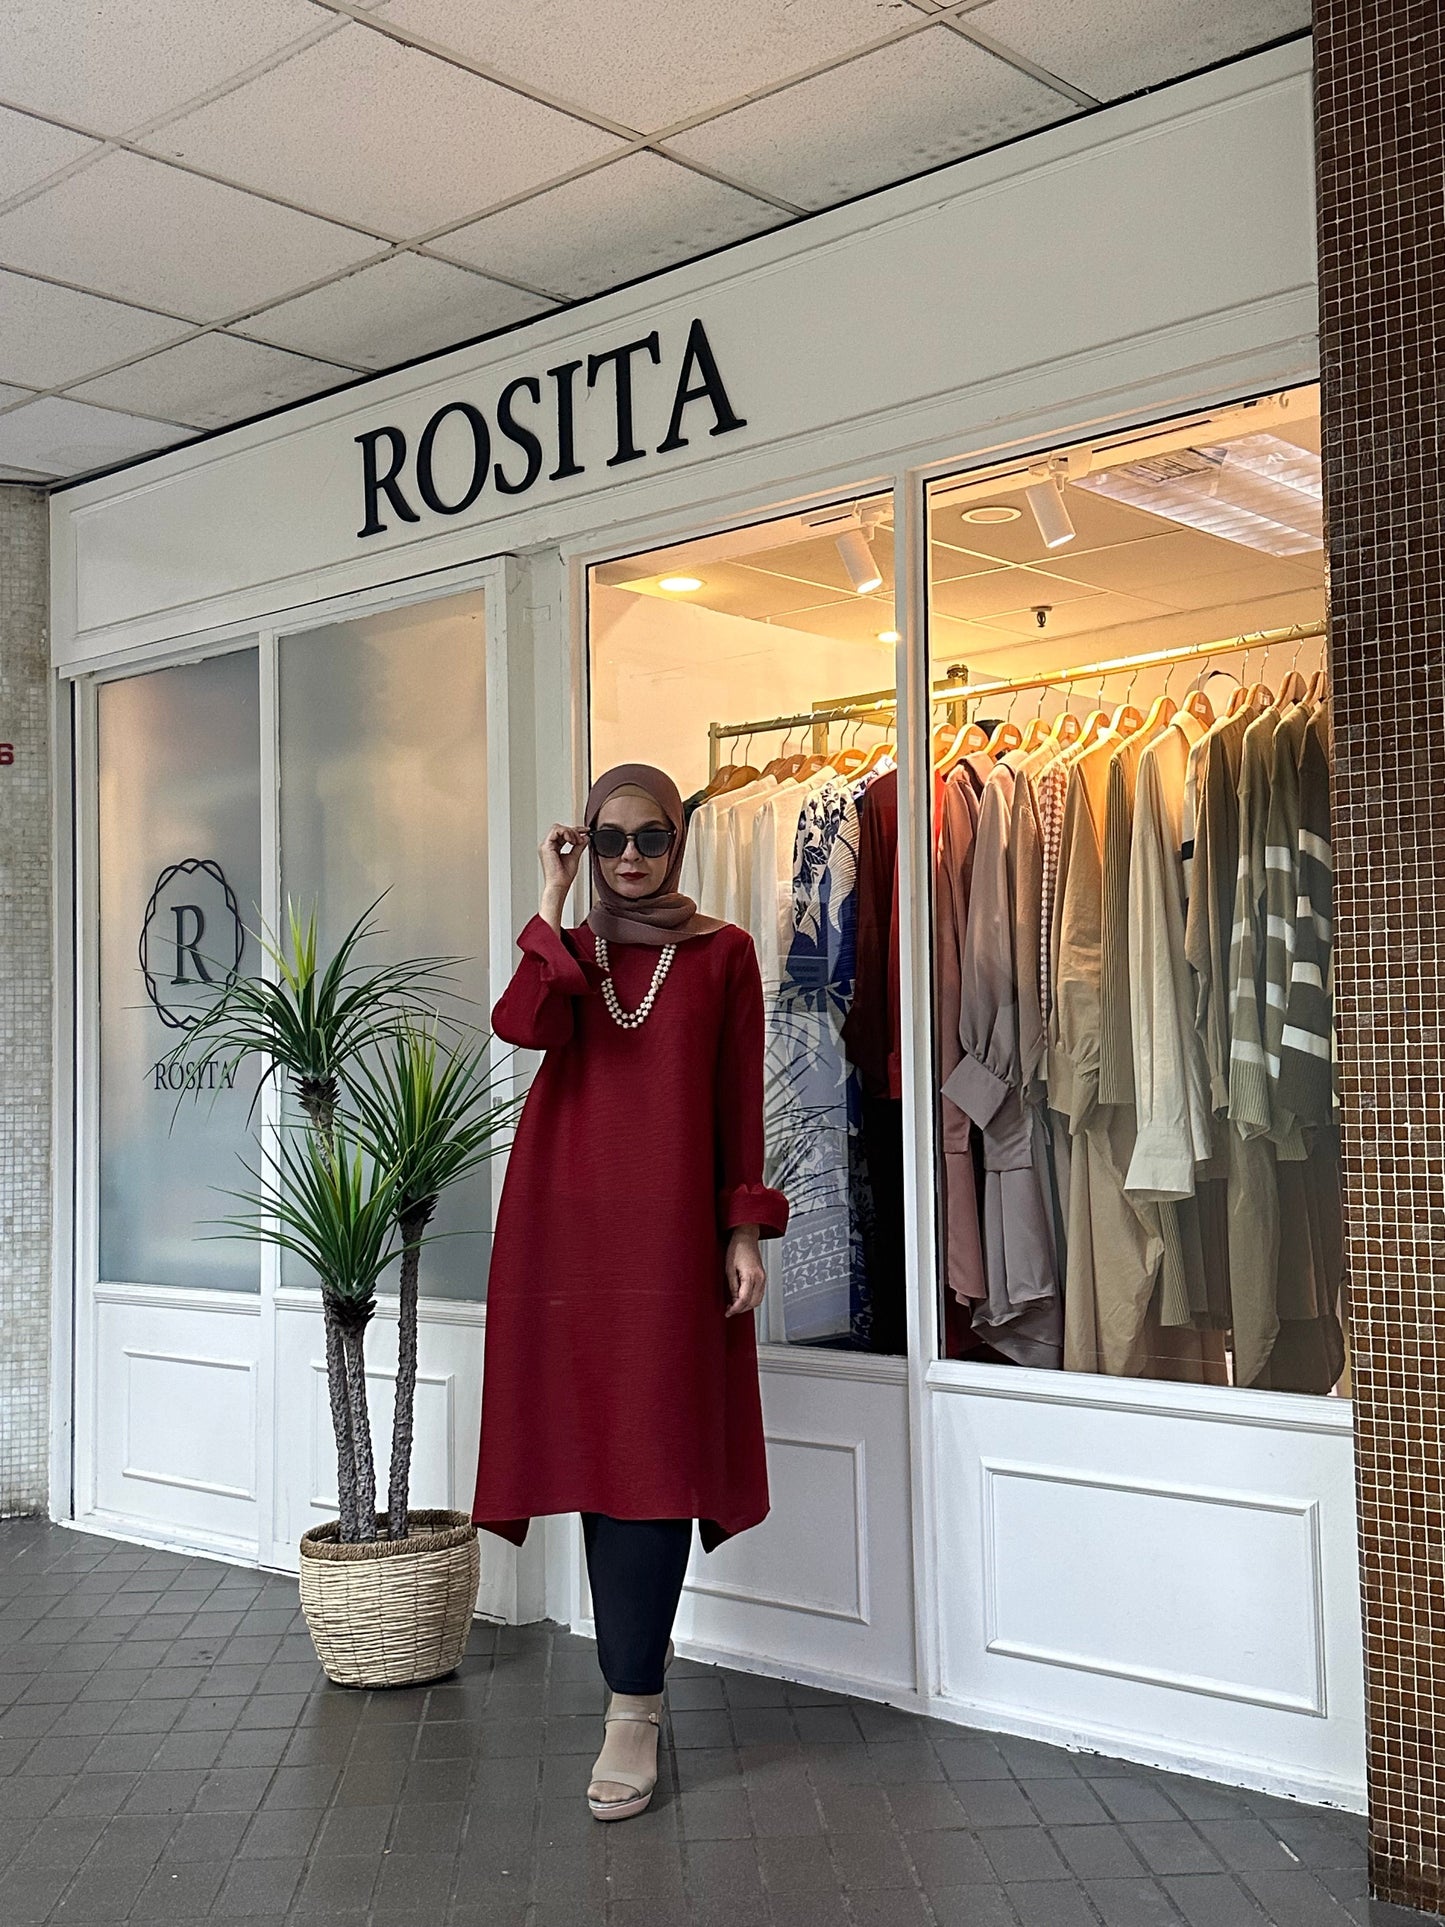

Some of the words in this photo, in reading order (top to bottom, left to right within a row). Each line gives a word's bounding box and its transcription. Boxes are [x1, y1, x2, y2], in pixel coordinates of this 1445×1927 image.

[354, 318, 747, 538] ROSITA
[171, 905, 212, 984] R
[154, 1060, 234, 1089] ROSITA
